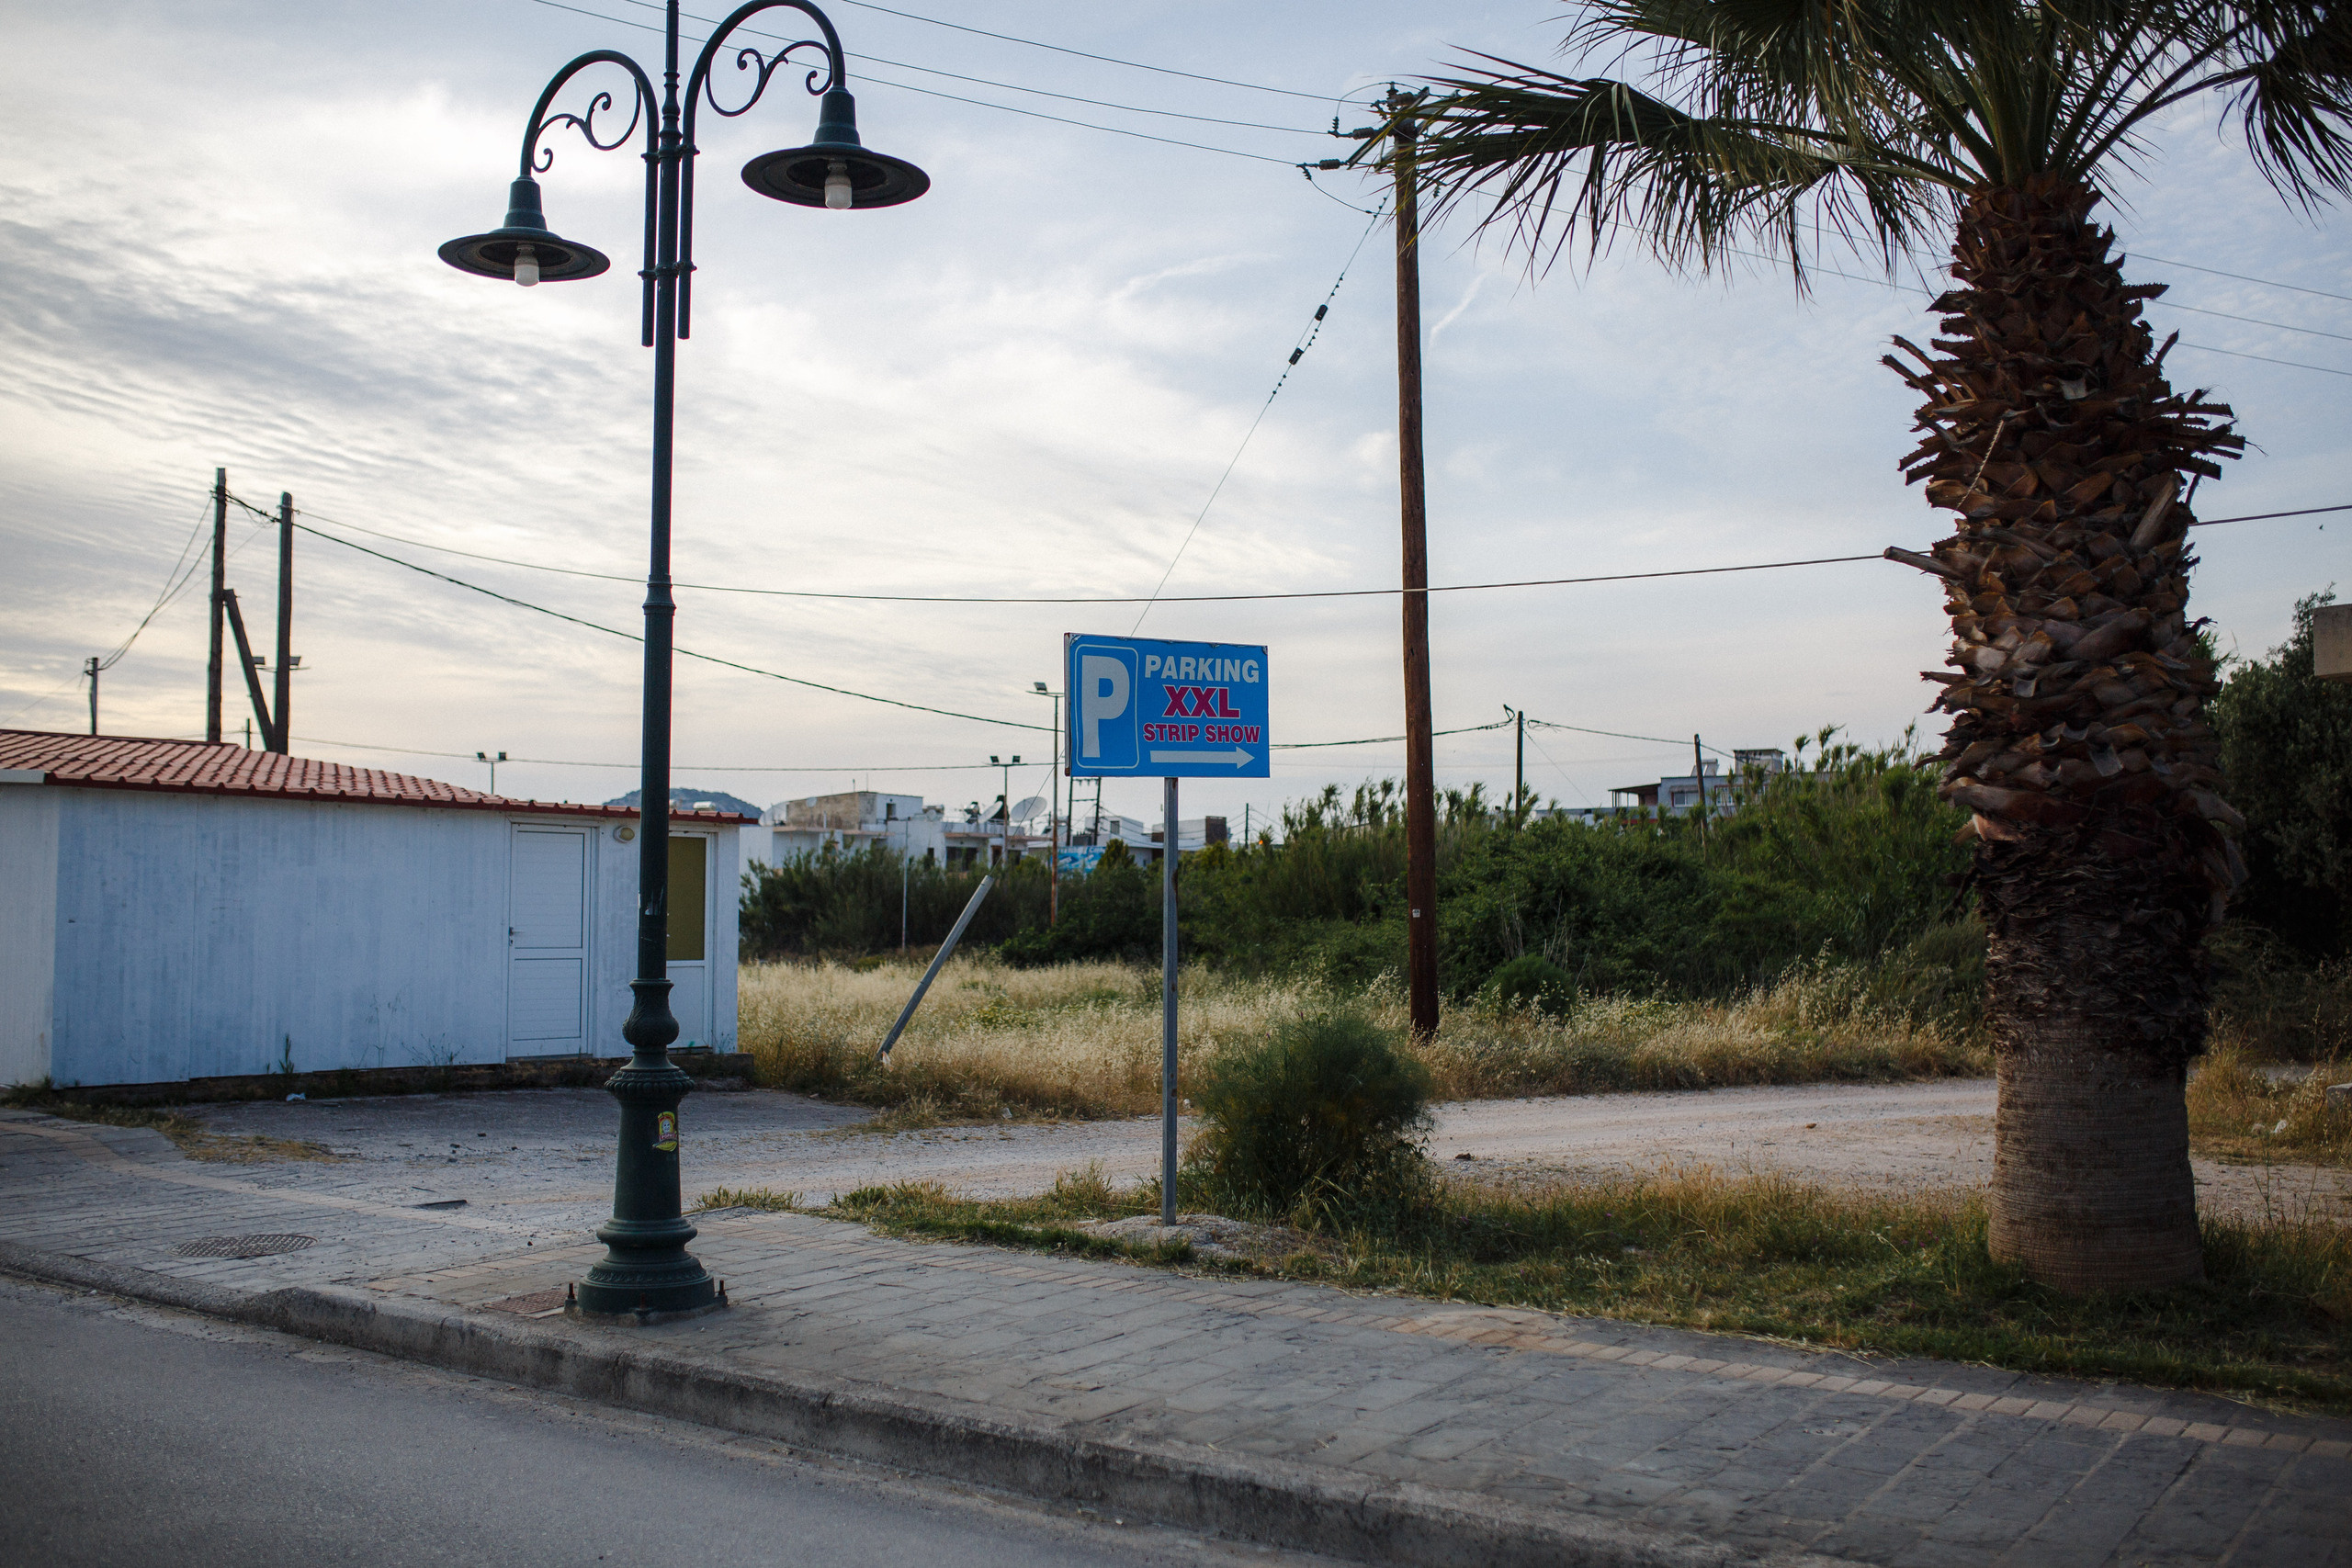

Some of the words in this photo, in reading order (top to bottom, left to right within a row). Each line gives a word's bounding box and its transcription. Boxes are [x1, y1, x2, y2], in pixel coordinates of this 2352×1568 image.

[1145, 654, 1260, 683] PARKING
[1081, 654, 1130, 758] P
[1161, 684, 1240, 718] XXL
[1143, 723, 1200, 742] STRIP
[1204, 724, 1261, 744] SHOW
